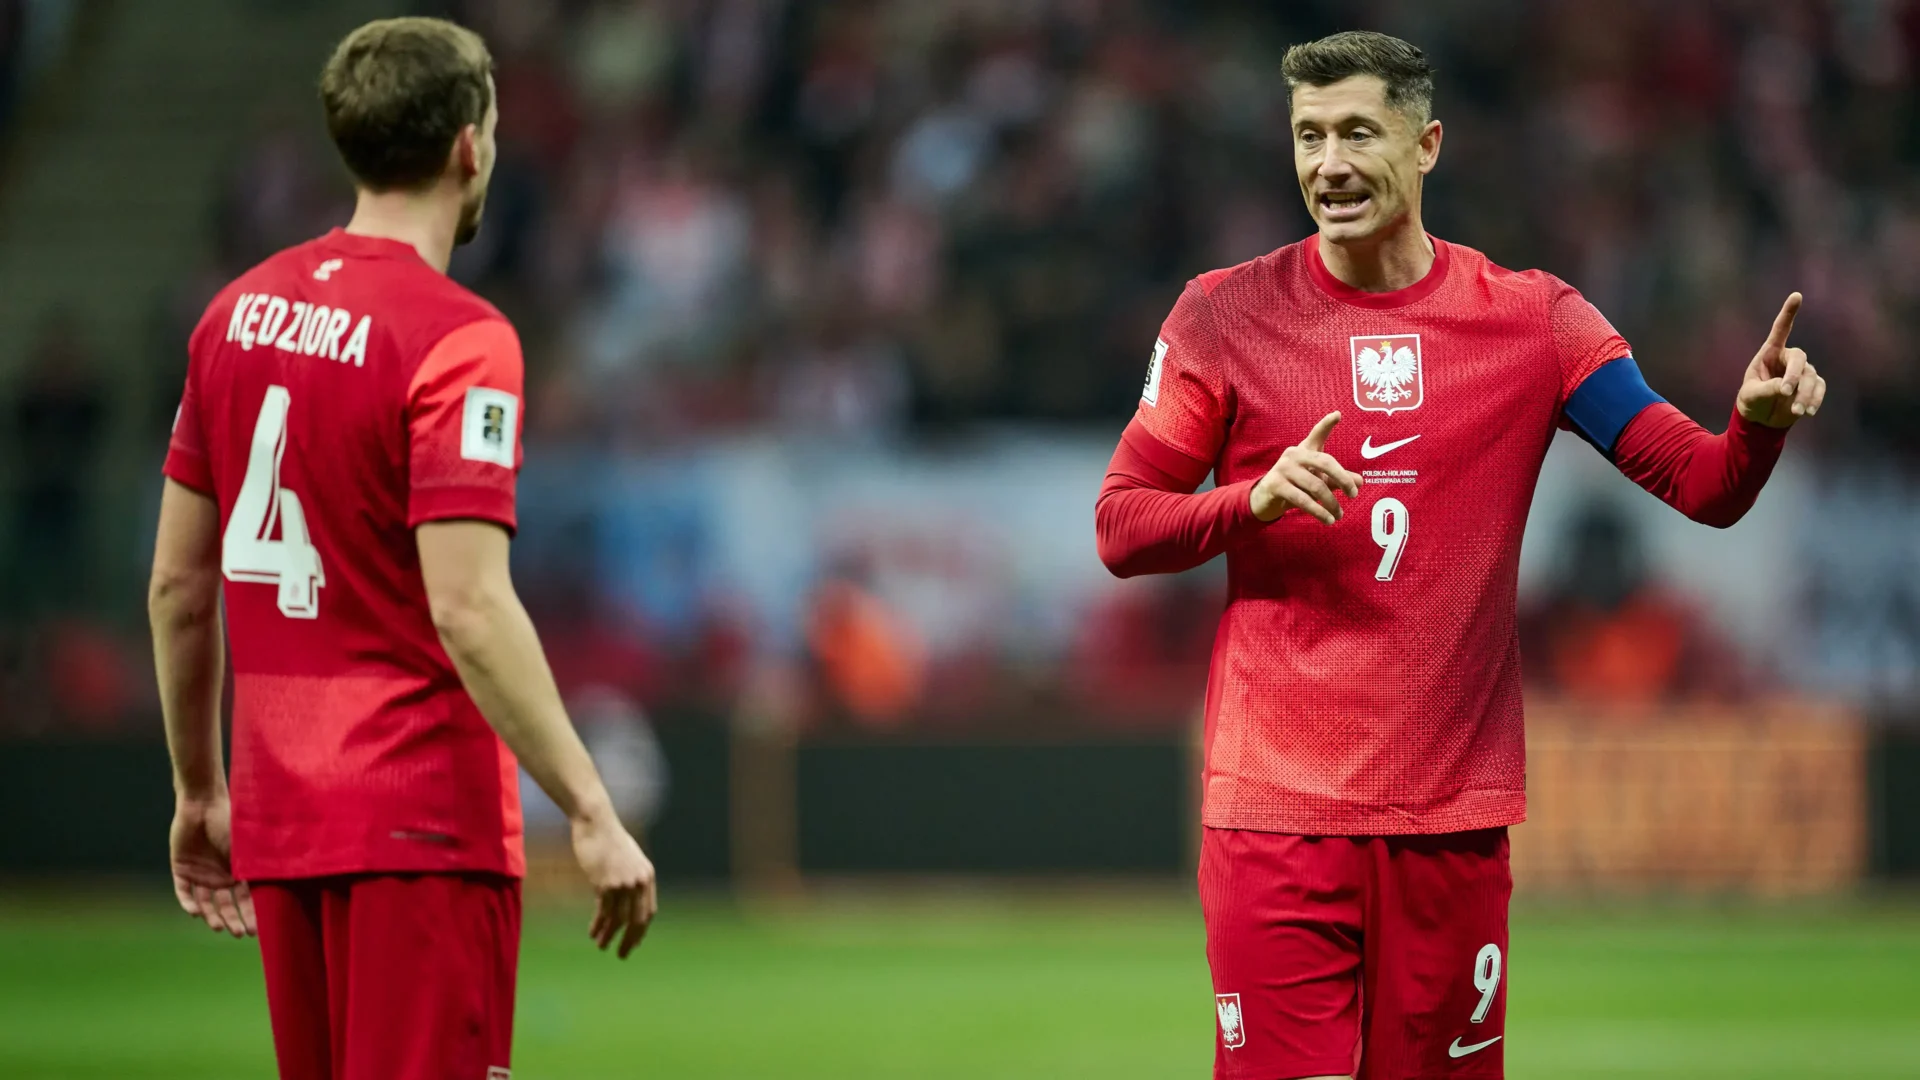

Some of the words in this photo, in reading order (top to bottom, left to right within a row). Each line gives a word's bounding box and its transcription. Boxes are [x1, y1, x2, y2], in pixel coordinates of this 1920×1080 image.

[226, 293, 372, 368] KĘDZIORA
[221, 384, 326, 619] 4
[1371, 497, 1409, 581] 9
[1470, 943, 1502, 1024] 9
